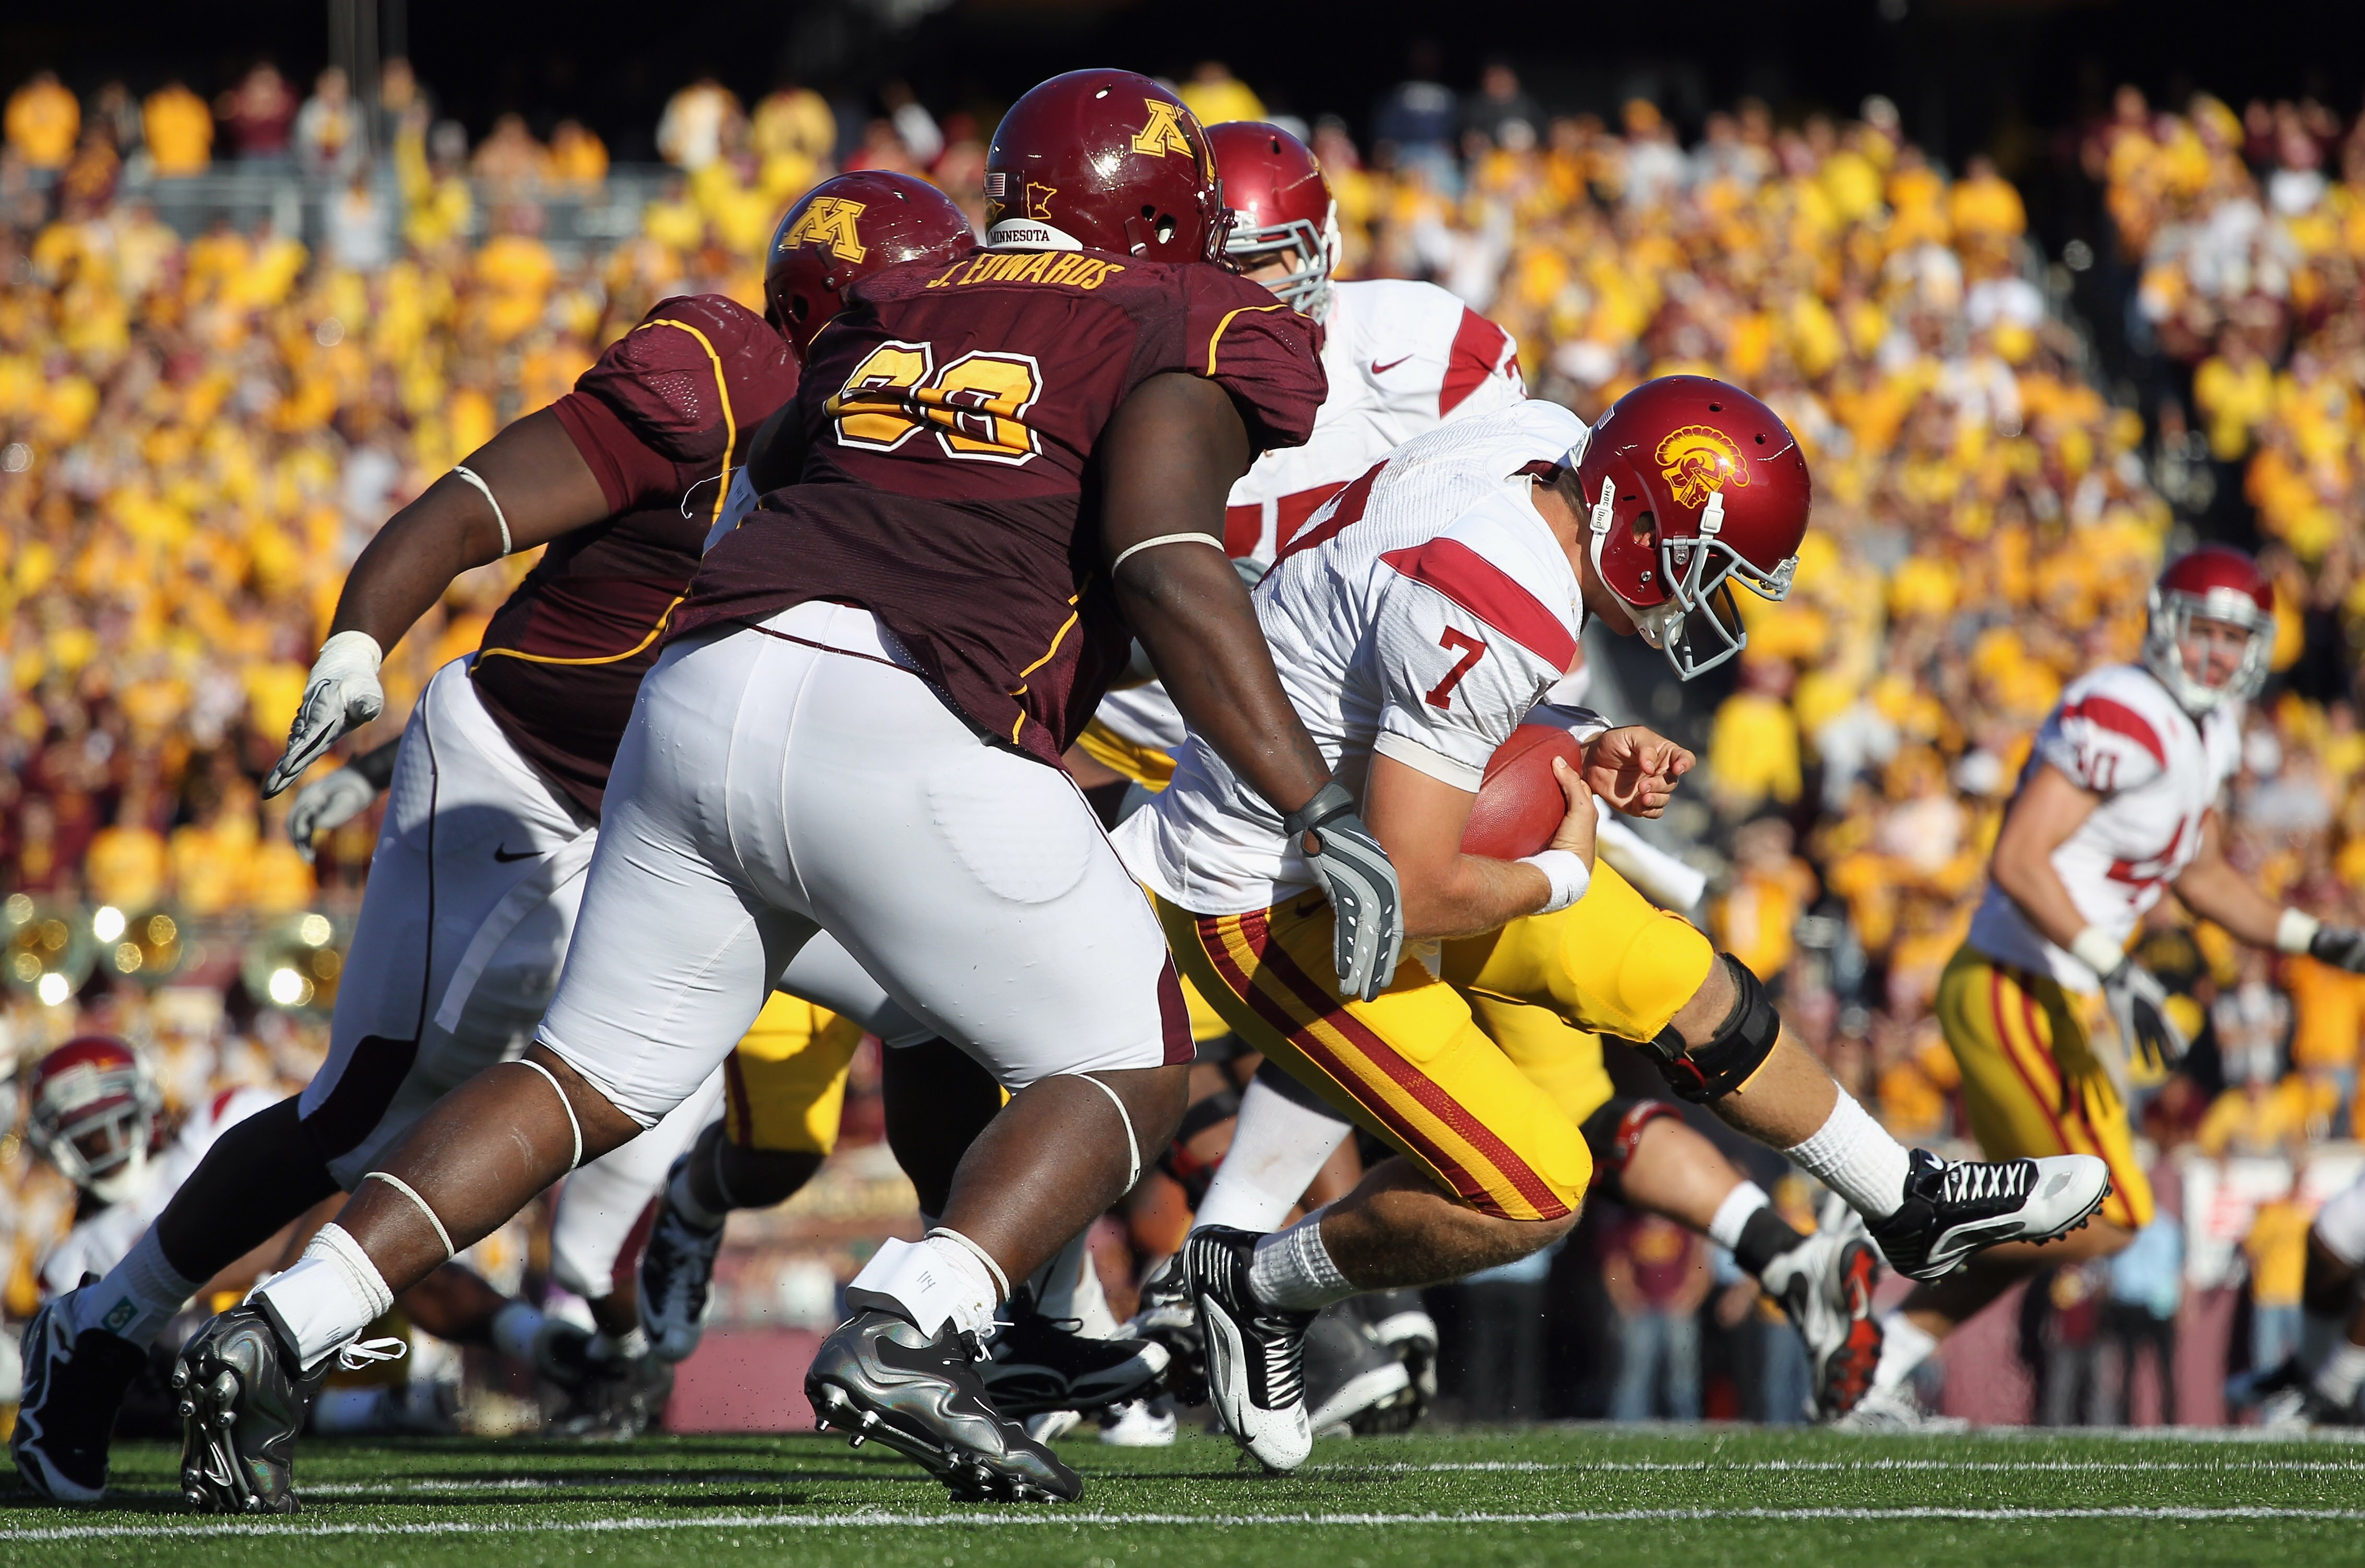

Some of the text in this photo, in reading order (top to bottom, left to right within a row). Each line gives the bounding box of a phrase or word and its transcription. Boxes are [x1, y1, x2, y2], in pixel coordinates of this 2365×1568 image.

[778, 196, 867, 264] M
[990, 230, 1050, 243] MINNESOTA
[926, 251, 1125, 290] J. EDWARDS
[1603, 484, 1612, 507] SHOC
[1425, 625, 1488, 710] 7
[916, 1270, 936, 1294] 114
